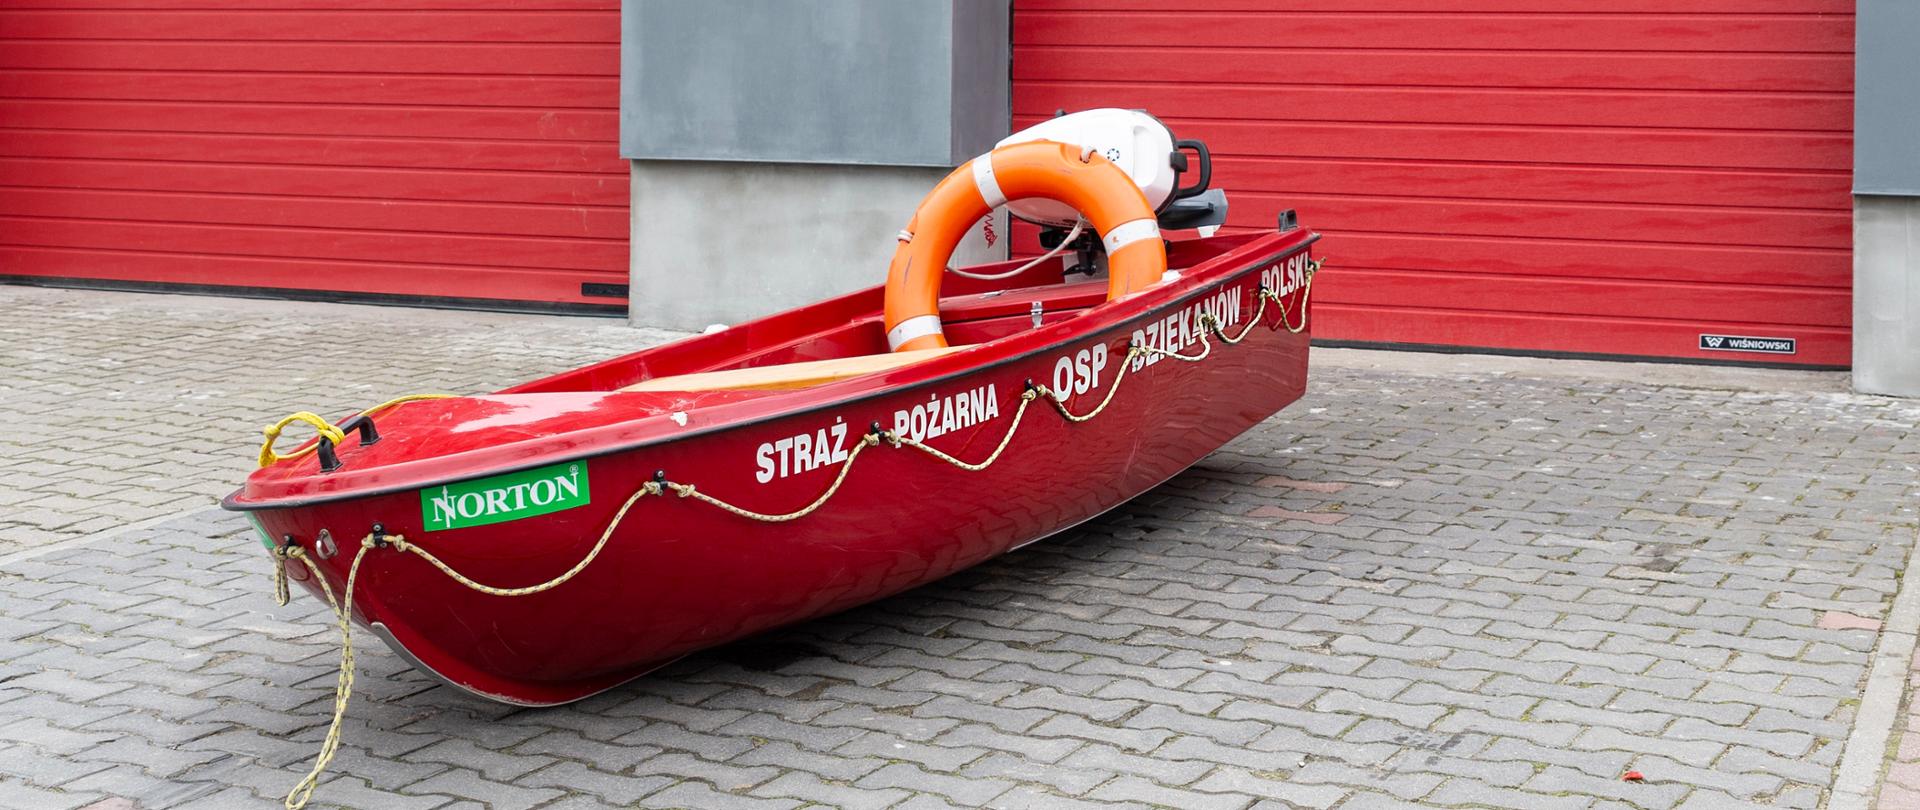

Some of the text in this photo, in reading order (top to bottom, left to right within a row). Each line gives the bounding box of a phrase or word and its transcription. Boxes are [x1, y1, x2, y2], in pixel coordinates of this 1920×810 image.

[755, 415, 849, 484] STRAŻ
[894, 383, 999, 449] POŻARNA
[1053, 342, 1108, 403] OSP
[1131, 284, 1242, 373] DZIEKANÓW
[1728, 338, 1791, 351] WIŚNIOWSKI
